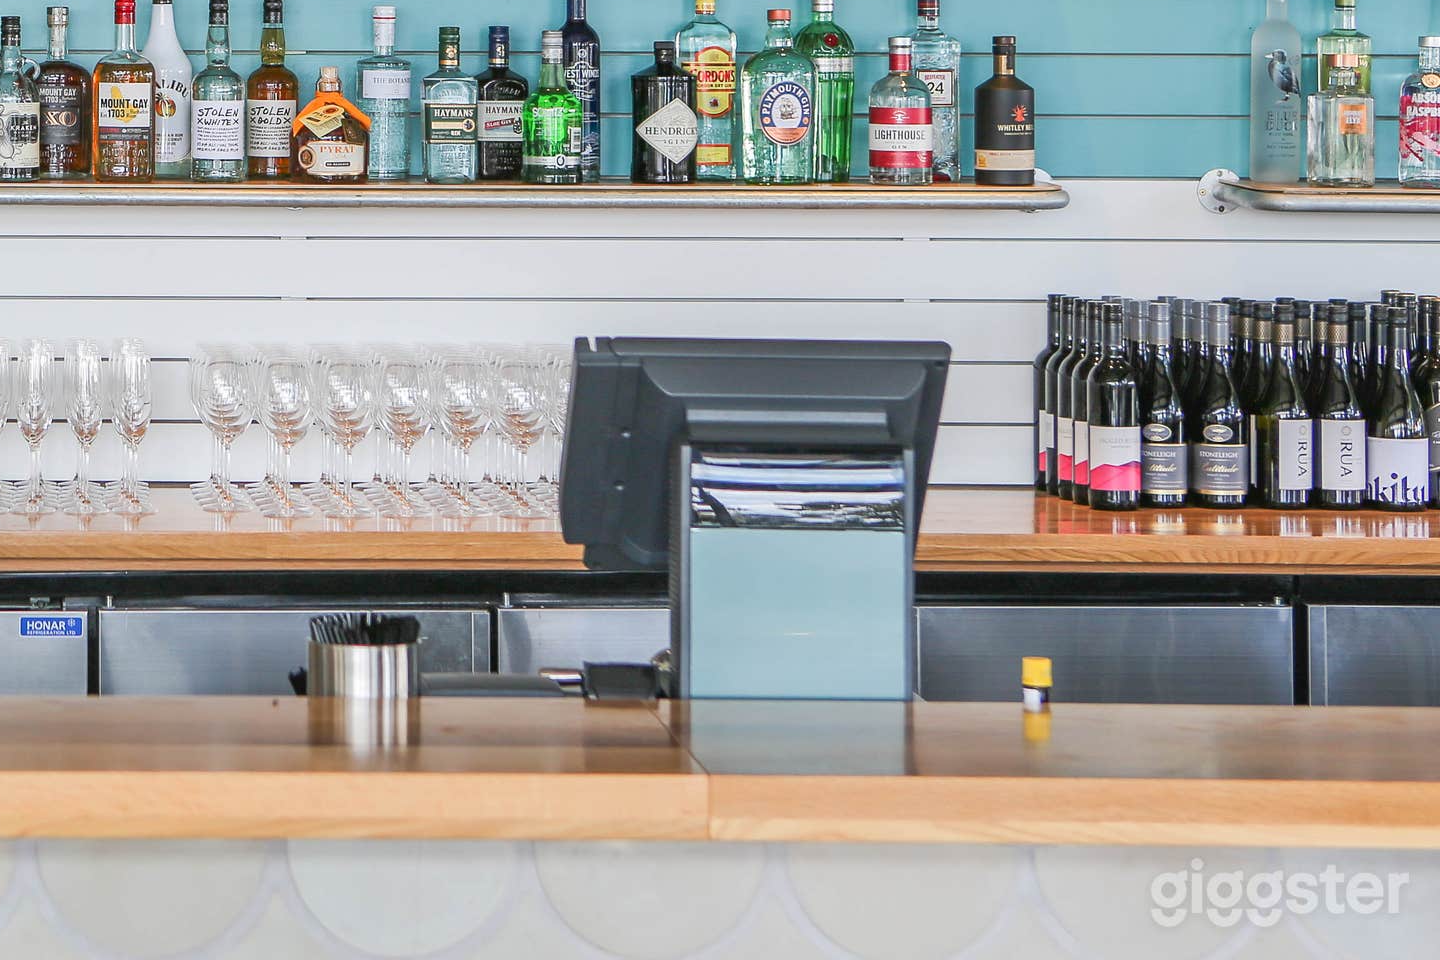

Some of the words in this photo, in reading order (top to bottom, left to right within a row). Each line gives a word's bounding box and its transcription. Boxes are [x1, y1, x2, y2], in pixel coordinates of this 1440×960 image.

[39, 87, 63, 97] MOUNT
[64, 87, 77, 97] GAY
[927, 81, 944, 95] 24
[101, 98, 131, 109] MOUNT
[132, 98, 148, 109] GAY
[762, 84, 803, 115] PLYMOUTH
[800, 96, 810, 115] GIN
[107, 108, 125, 118] 1703
[197, 107, 239, 117] STOLEN
[250, 106, 291, 117] STOLEN
[44, 110, 78, 128] XO
[645, 126, 698, 136] HENDRICK
[874, 129, 927, 141] LIGHTHOUSE
[1297, 441, 1308, 477] RUA
[1340, 442, 1353, 478] RUA
[1368, 472, 1426, 504] kitu
[26, 620, 66, 631] HONAR
